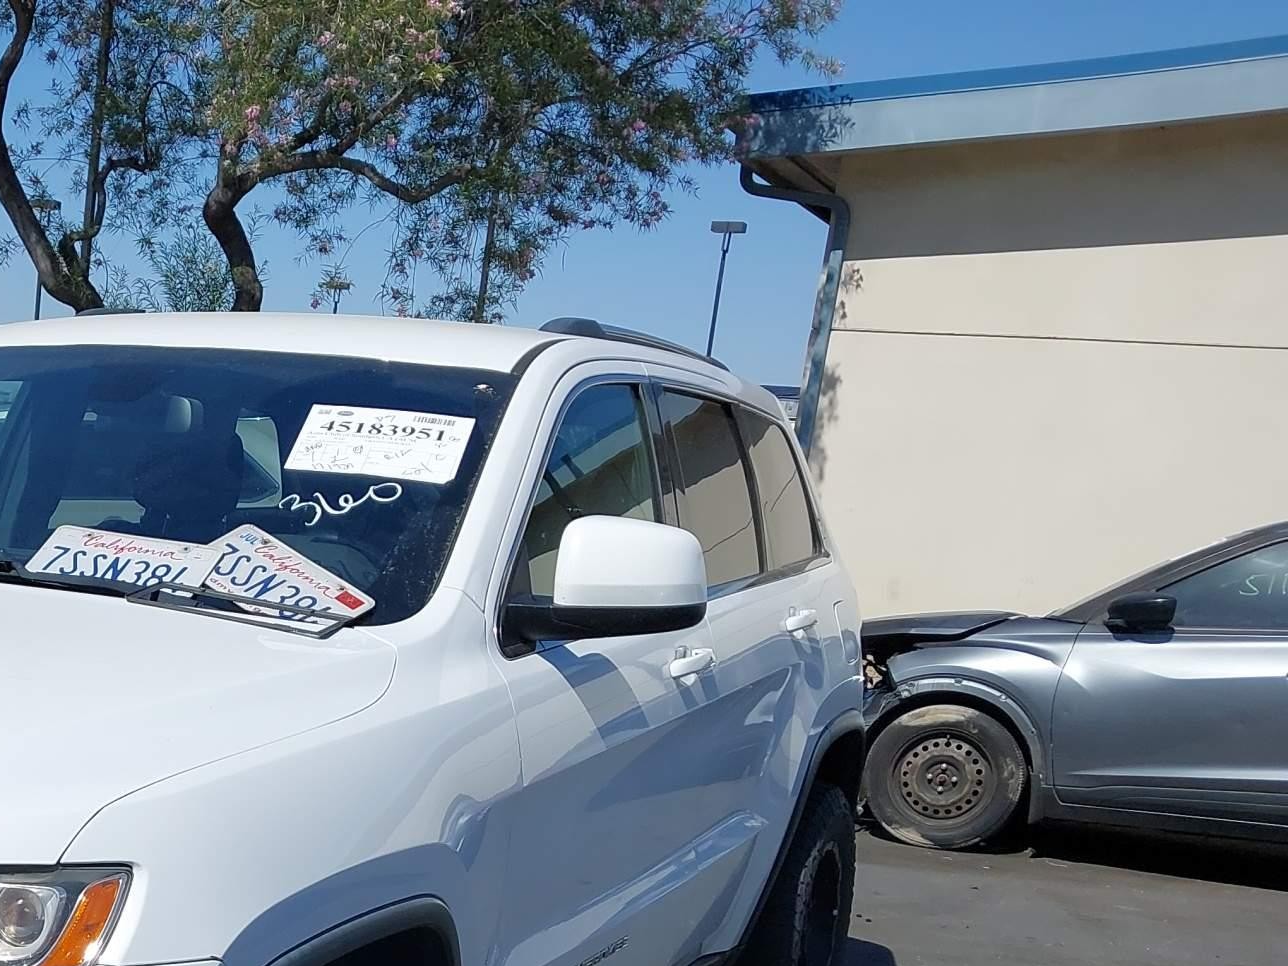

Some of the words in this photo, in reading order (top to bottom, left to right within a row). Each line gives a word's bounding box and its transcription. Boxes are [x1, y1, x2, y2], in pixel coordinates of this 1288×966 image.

[320, 420, 446, 442] 45183951
[279, 483, 402, 526] 360
[82, 533, 184, 561] California
[239, 532, 260, 545] JUL
[253, 545, 336, 600] California
